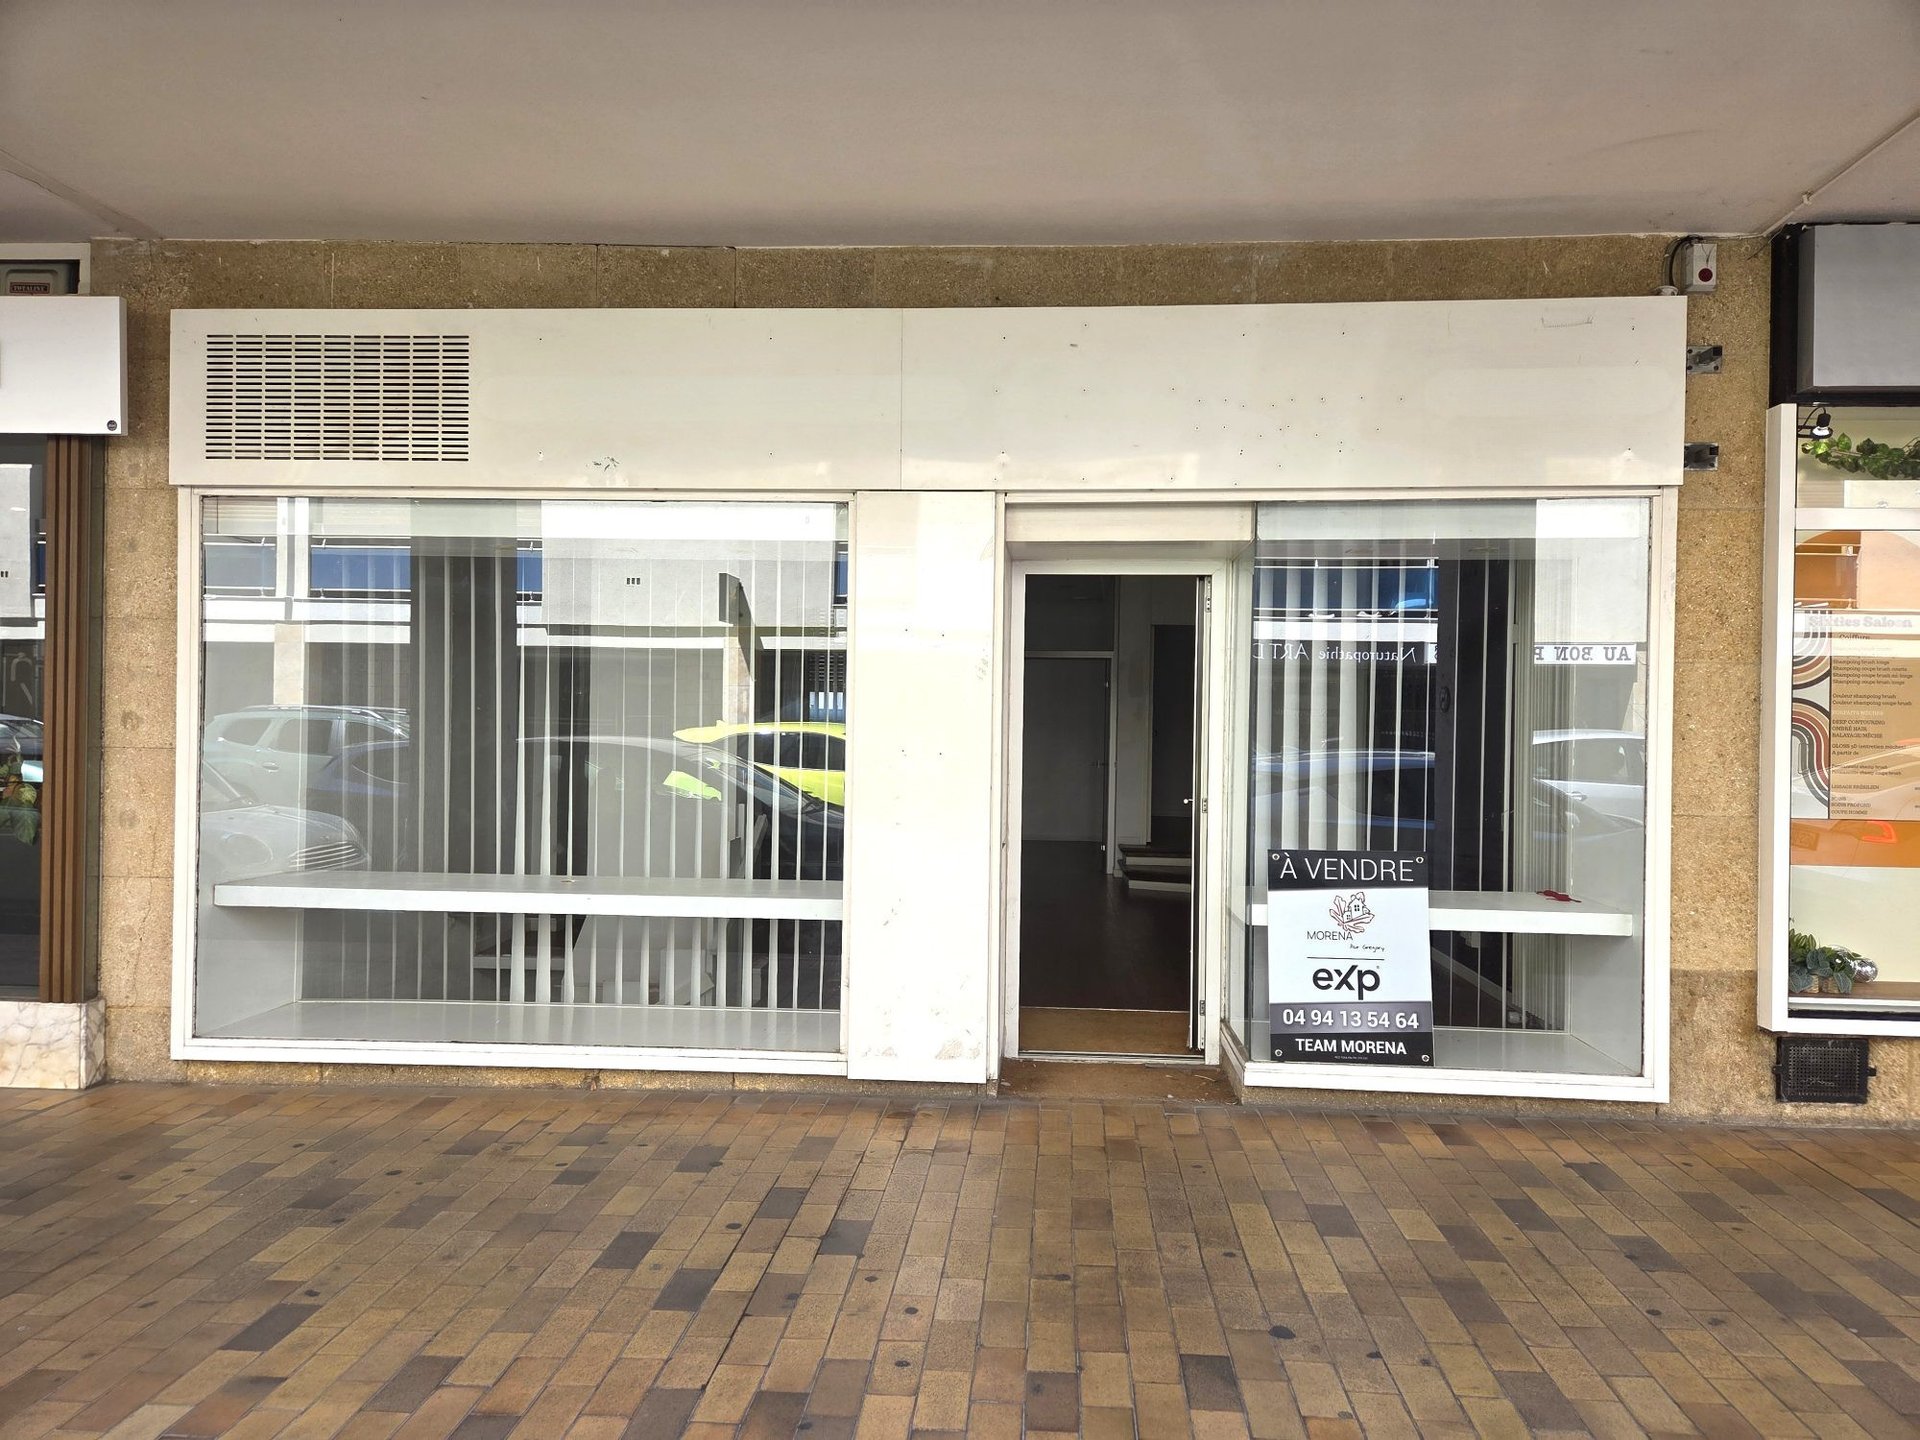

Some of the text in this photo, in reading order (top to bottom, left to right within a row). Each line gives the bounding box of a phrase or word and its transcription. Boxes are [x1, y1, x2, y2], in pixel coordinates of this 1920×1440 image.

[1280, 852, 1414, 882] À VENDRE
[1306, 930, 1354, 941] MORENA
[1283, 1008, 1420, 1029] 04 94 13 54 64
[1295, 1038, 1407, 1055] TEAM MORENA
